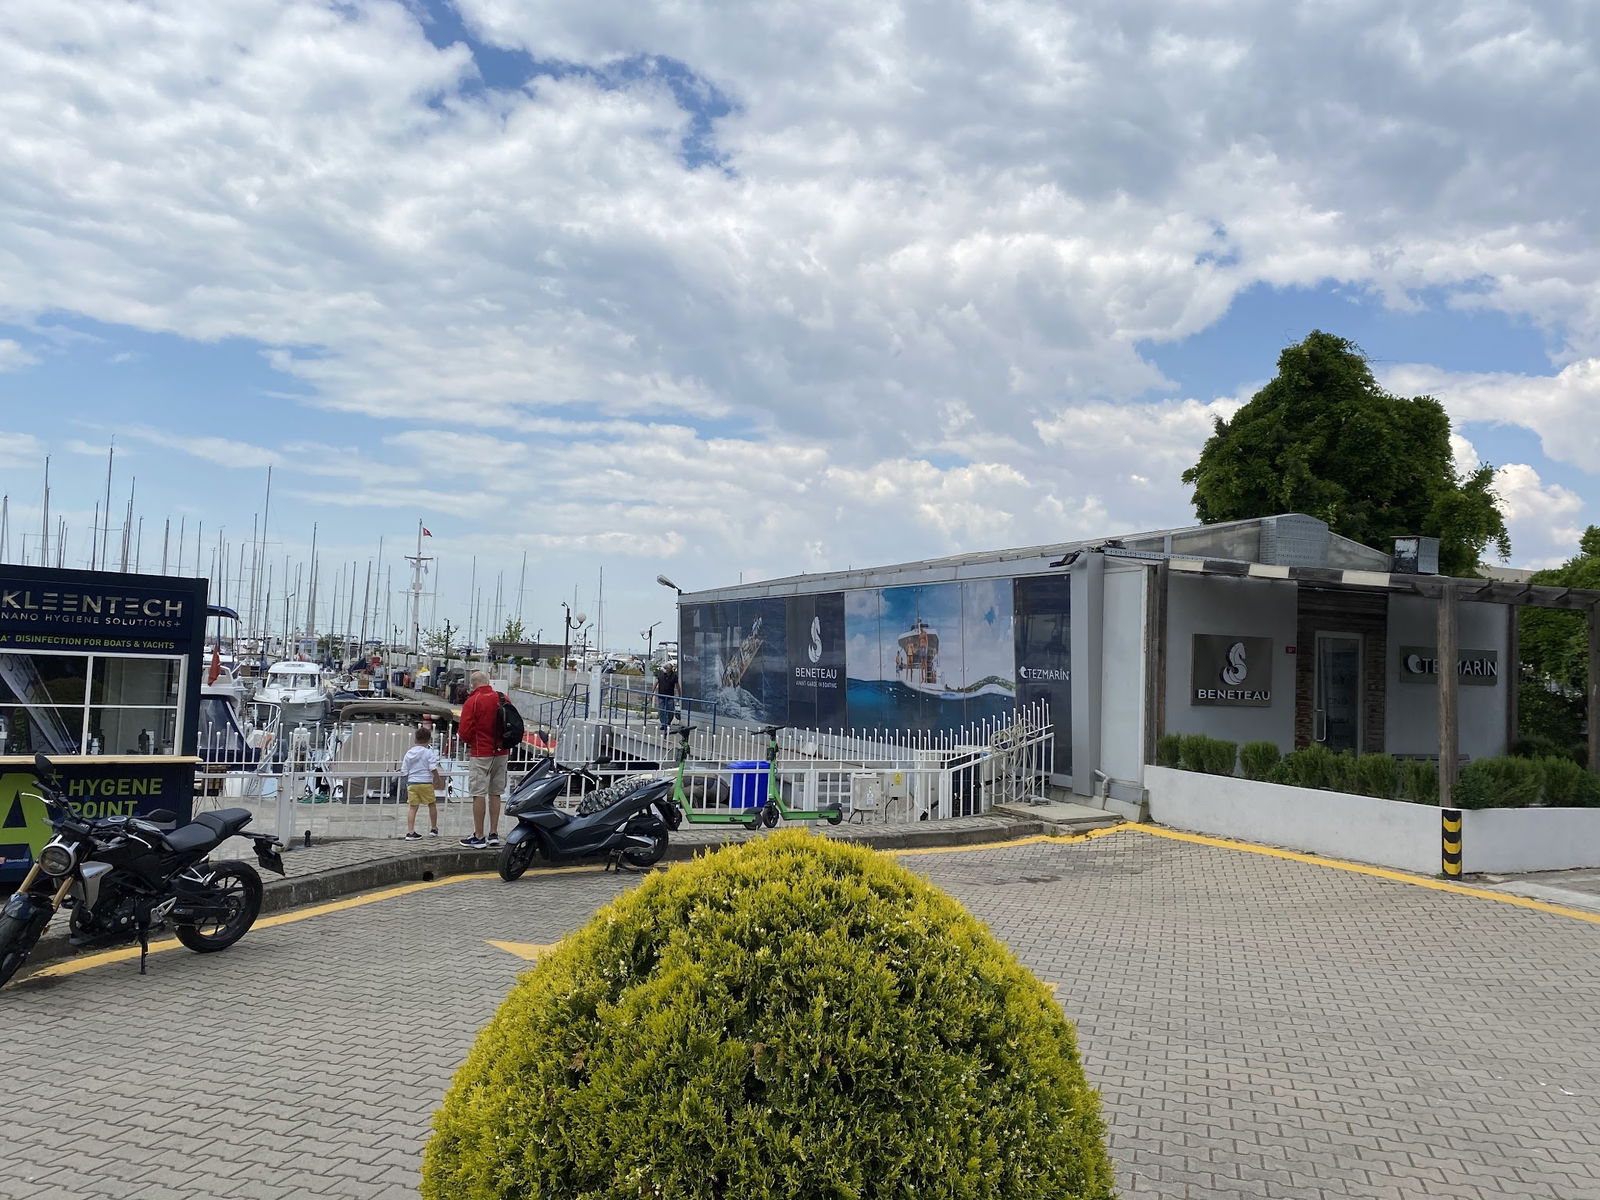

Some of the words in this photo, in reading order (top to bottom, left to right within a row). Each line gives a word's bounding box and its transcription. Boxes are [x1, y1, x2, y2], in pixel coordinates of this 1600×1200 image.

[1, 589, 183, 618] KLEENTECH
[1, 612, 39, 621] NANO
[45, 614, 99, 624] HYGIENE
[15, 634, 82, 646] DISINFECTION
[83, 638, 102, 646] FOR
[103, 639, 132, 648] BOATS
[142, 641, 175, 649] YACHTS
[795, 667, 837, 679] BENETEAU
[1198, 689, 1271, 701] BENETEAU
[68, 778, 164, 797] HYGENE
